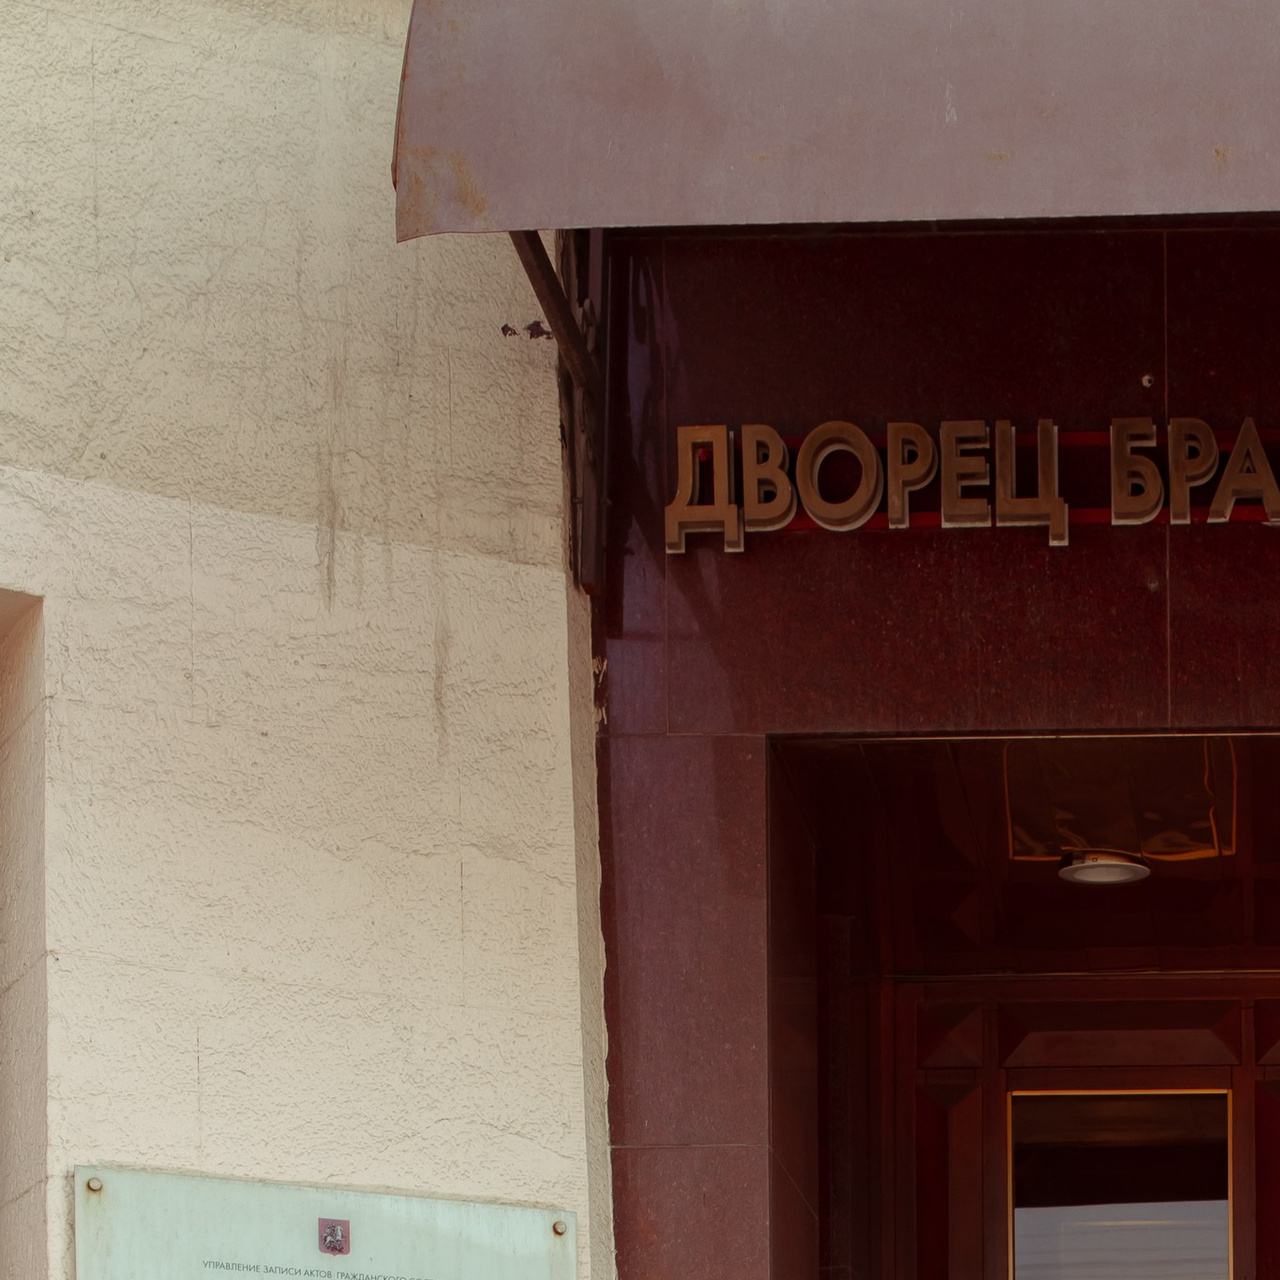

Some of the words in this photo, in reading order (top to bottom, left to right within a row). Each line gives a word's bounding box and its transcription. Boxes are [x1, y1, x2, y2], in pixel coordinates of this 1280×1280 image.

[665, 418, 1069, 554] ДВОРЕЦ
[202, 1261, 260, 1273] УПРАВЛЕНИЕ
[263, 1266, 301, 1276] ЗАПИСИ
[303, 1270, 332, 1278] АКТОВ
